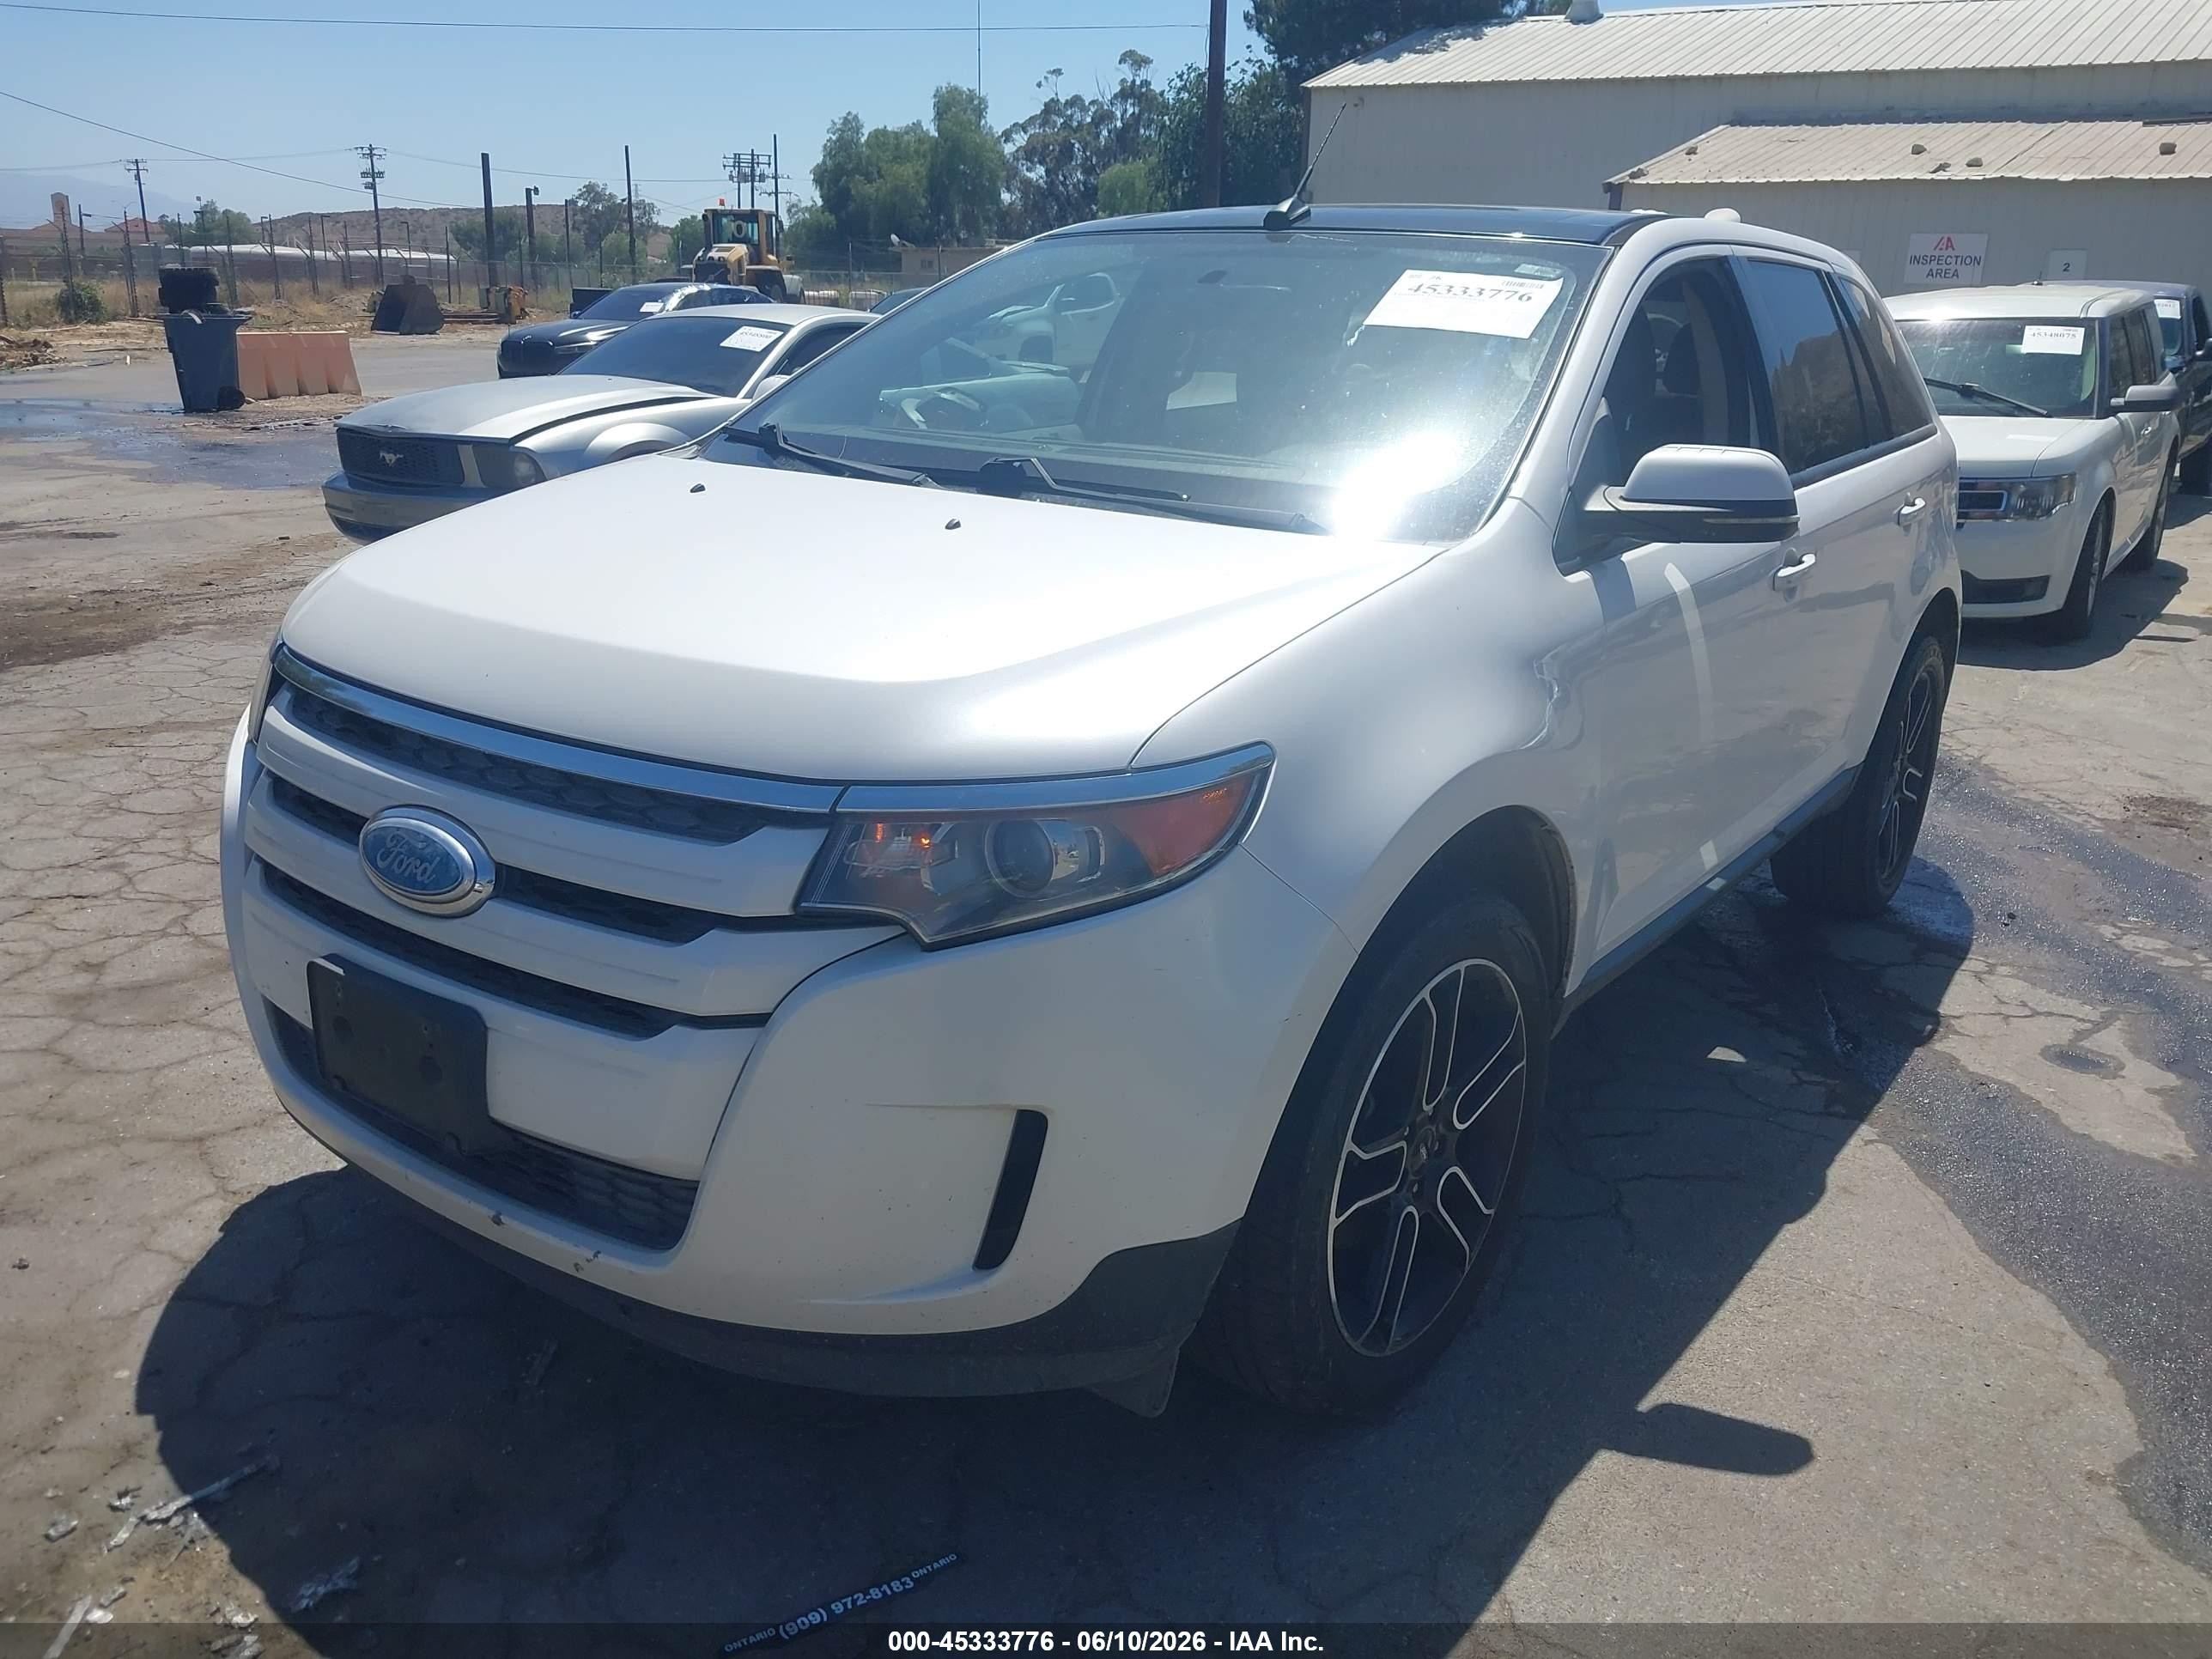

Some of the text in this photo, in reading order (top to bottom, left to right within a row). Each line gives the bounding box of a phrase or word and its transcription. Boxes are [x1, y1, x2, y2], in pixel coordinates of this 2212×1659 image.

[1909, 254, 1982, 267] INSPECTION
[2063, 262, 2070, 272] 2
[1925, 268, 1960, 279] AREA
[1407, 283, 1533, 302] 45333776
[376, 831, 441, 884] Ford
[724, 1553, 957, 1653] ONTARIO (909) 972-8183 ONTARIO
